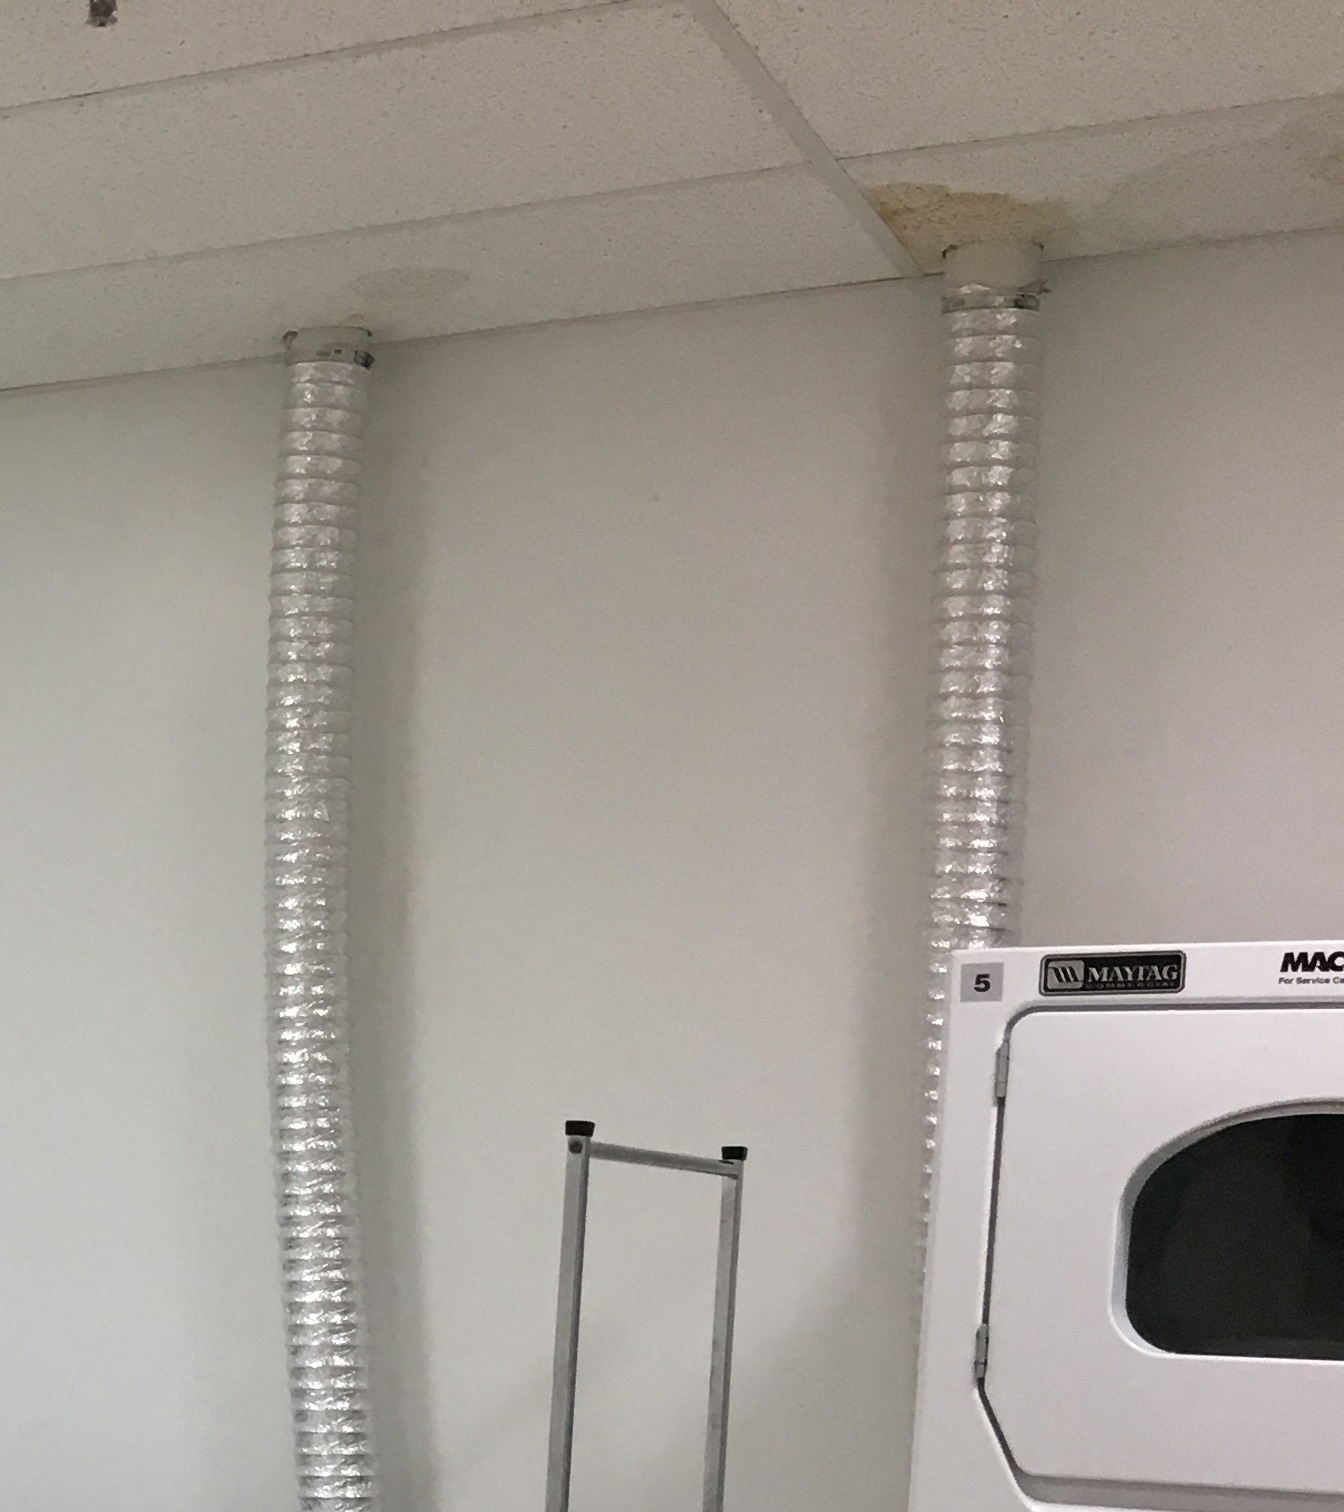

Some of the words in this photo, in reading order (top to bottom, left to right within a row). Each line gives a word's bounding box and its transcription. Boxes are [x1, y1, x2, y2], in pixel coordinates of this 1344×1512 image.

[1087, 963, 1179, 983] MAYTAG
[1279, 976, 1294, 985] For
[1296, 976, 1330, 985] Service
[973, 974, 992, 992] 5
